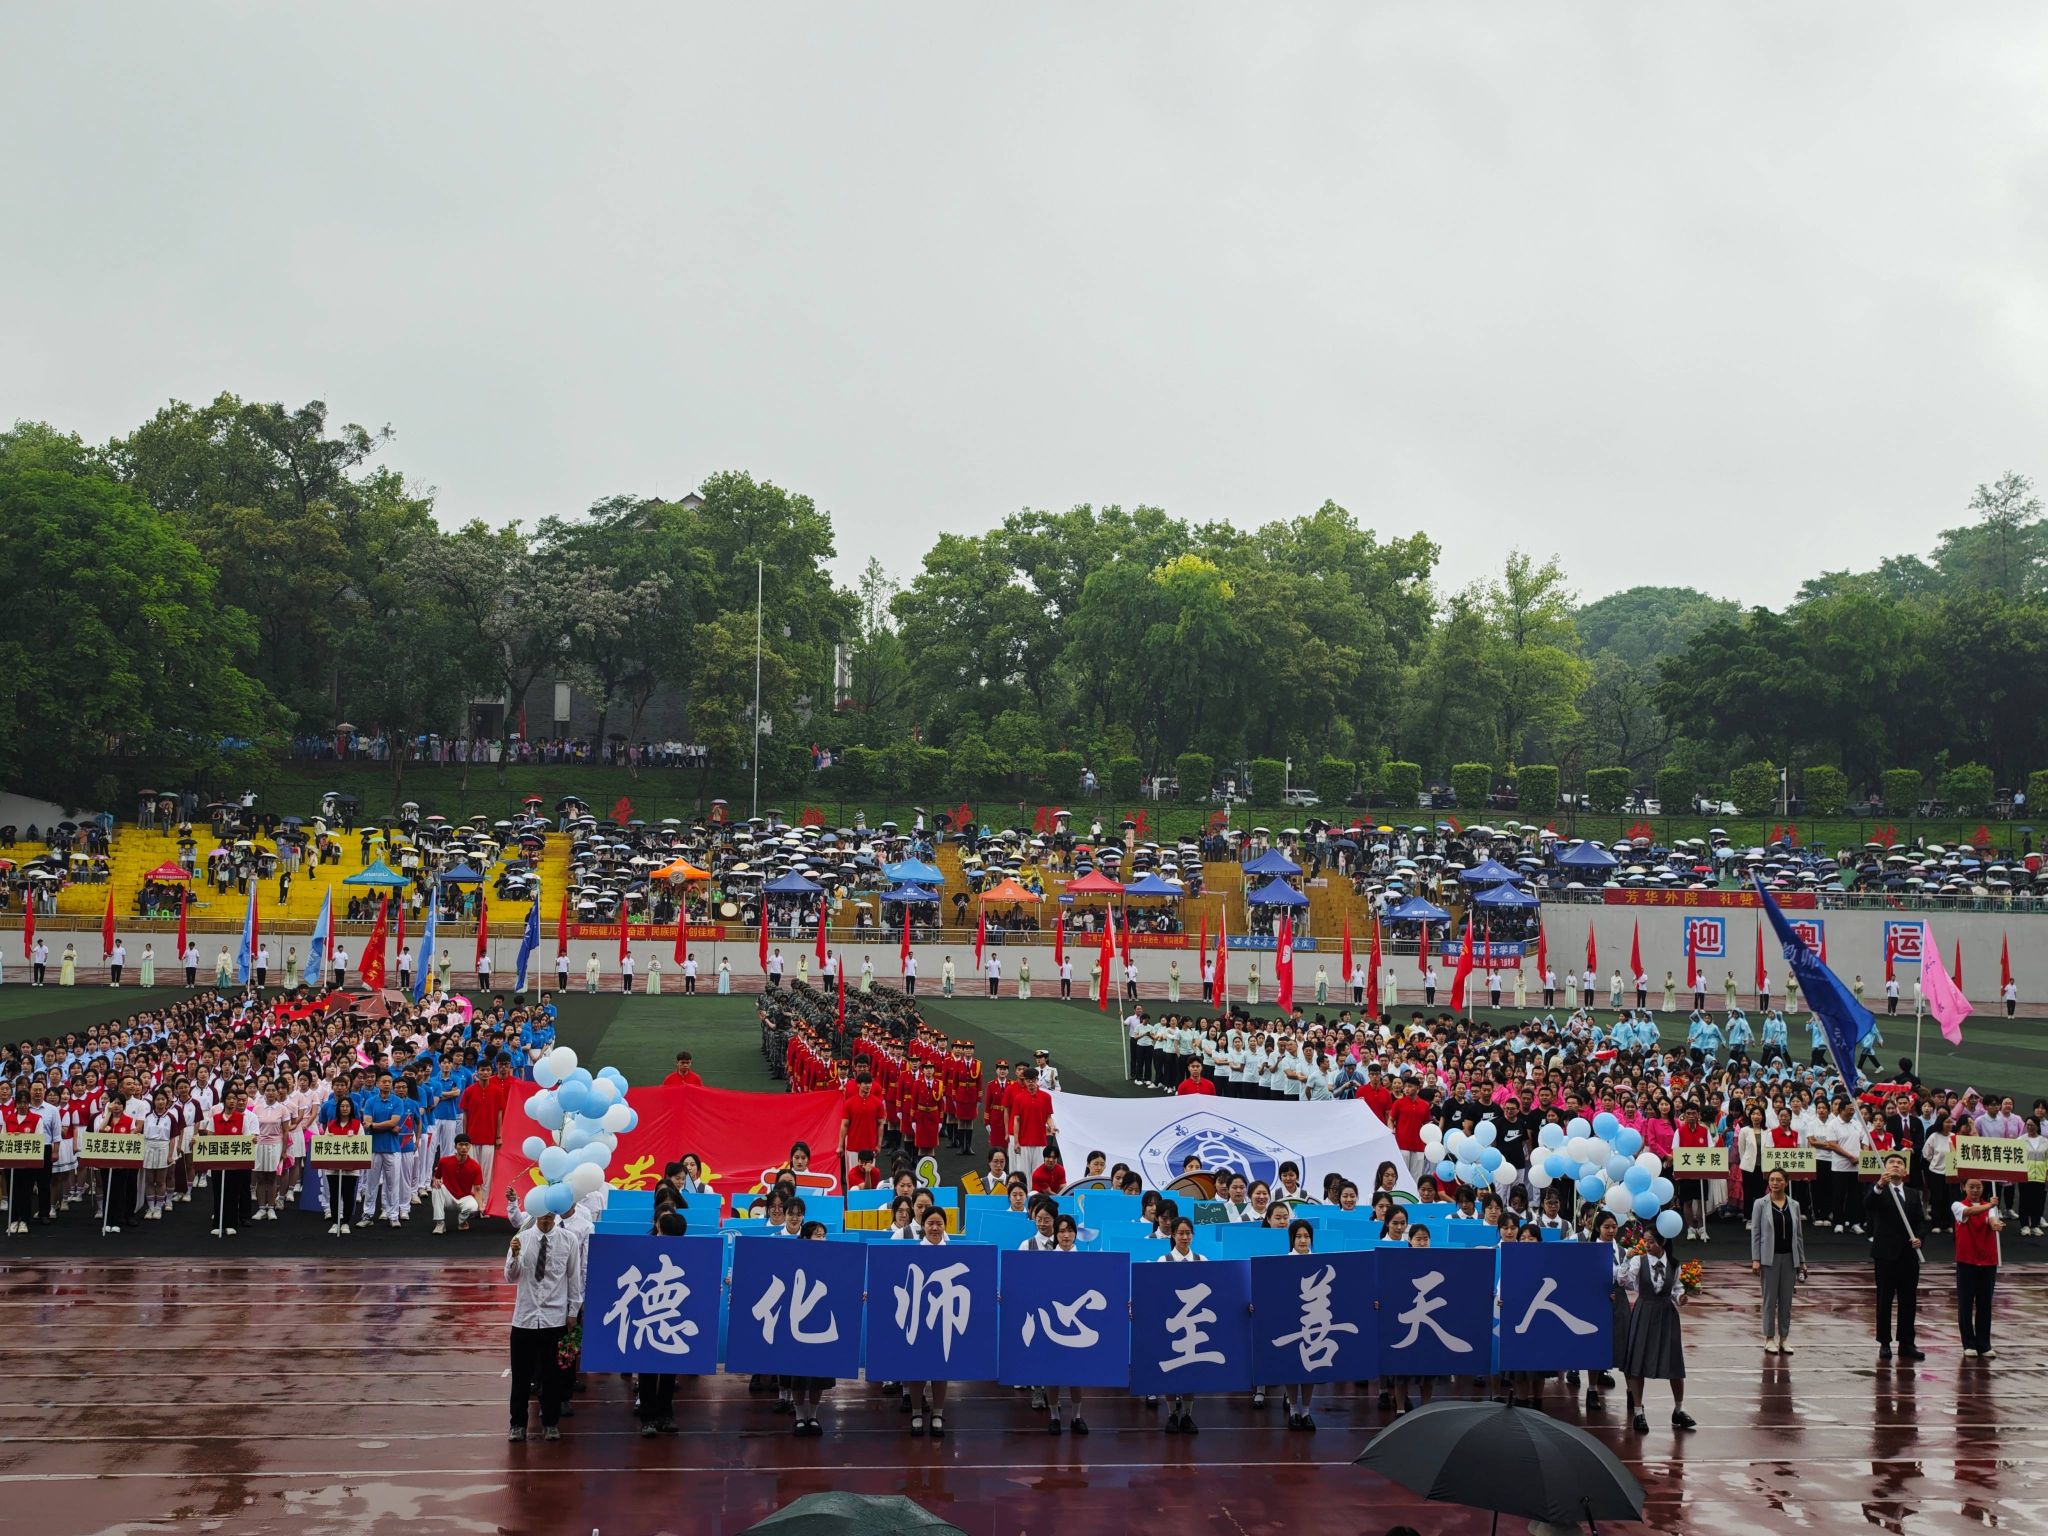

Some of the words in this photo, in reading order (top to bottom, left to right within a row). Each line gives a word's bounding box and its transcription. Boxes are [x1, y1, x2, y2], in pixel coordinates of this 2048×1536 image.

[1625, 889, 1699, 905] 芳华外院
[1720, 892, 1794, 906] 礼赞兰
[651, 926, 717, 938] 民族同创佳绩
[1691, 921, 1720, 953] 迎
[1891, 926, 1922, 957] 运
[85, 1138, 142, 1154] 马克思主义学院
[197, 1141, 252, 1156] 外国语学院
[314, 1140, 369, 1156] 研究生代表队
[1681, 1152, 1722, 1166] 文学院
[1767, 1151, 1813, 1160] 历史文化学院
[1960, 1143, 2025, 1165] 教师教育学院
[1774, 1160, 1806, 1169] 民族学院
